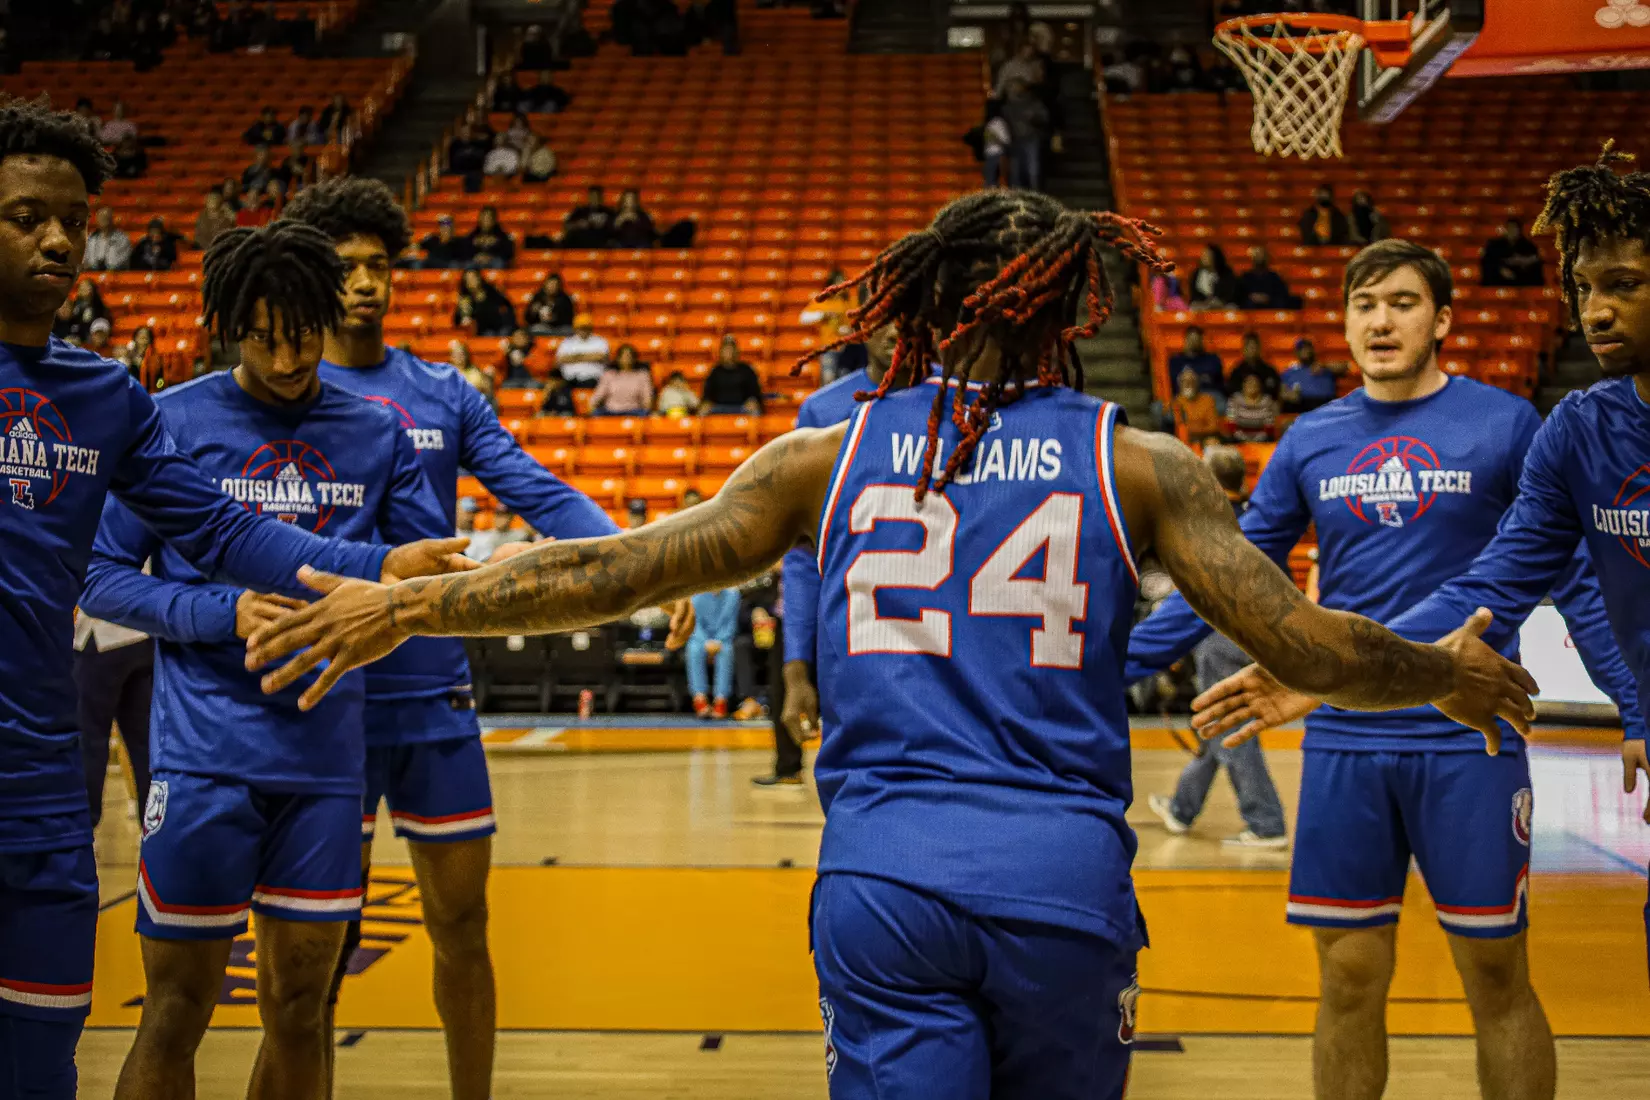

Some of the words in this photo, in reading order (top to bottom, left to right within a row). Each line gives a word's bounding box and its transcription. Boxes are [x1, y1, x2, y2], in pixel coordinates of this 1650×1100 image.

[9, 430, 38, 440] adidas
[53, 443, 100, 475] TECH
[891, 432, 1062, 485] WLLIAMS
[212, 477, 314, 503] OUISIANA
[317, 482, 365, 507] TECH
[1319, 471, 1413, 501] LOUISIANA
[1418, 470, 1472, 494] TECH
[845, 484, 1088, 669] 24
